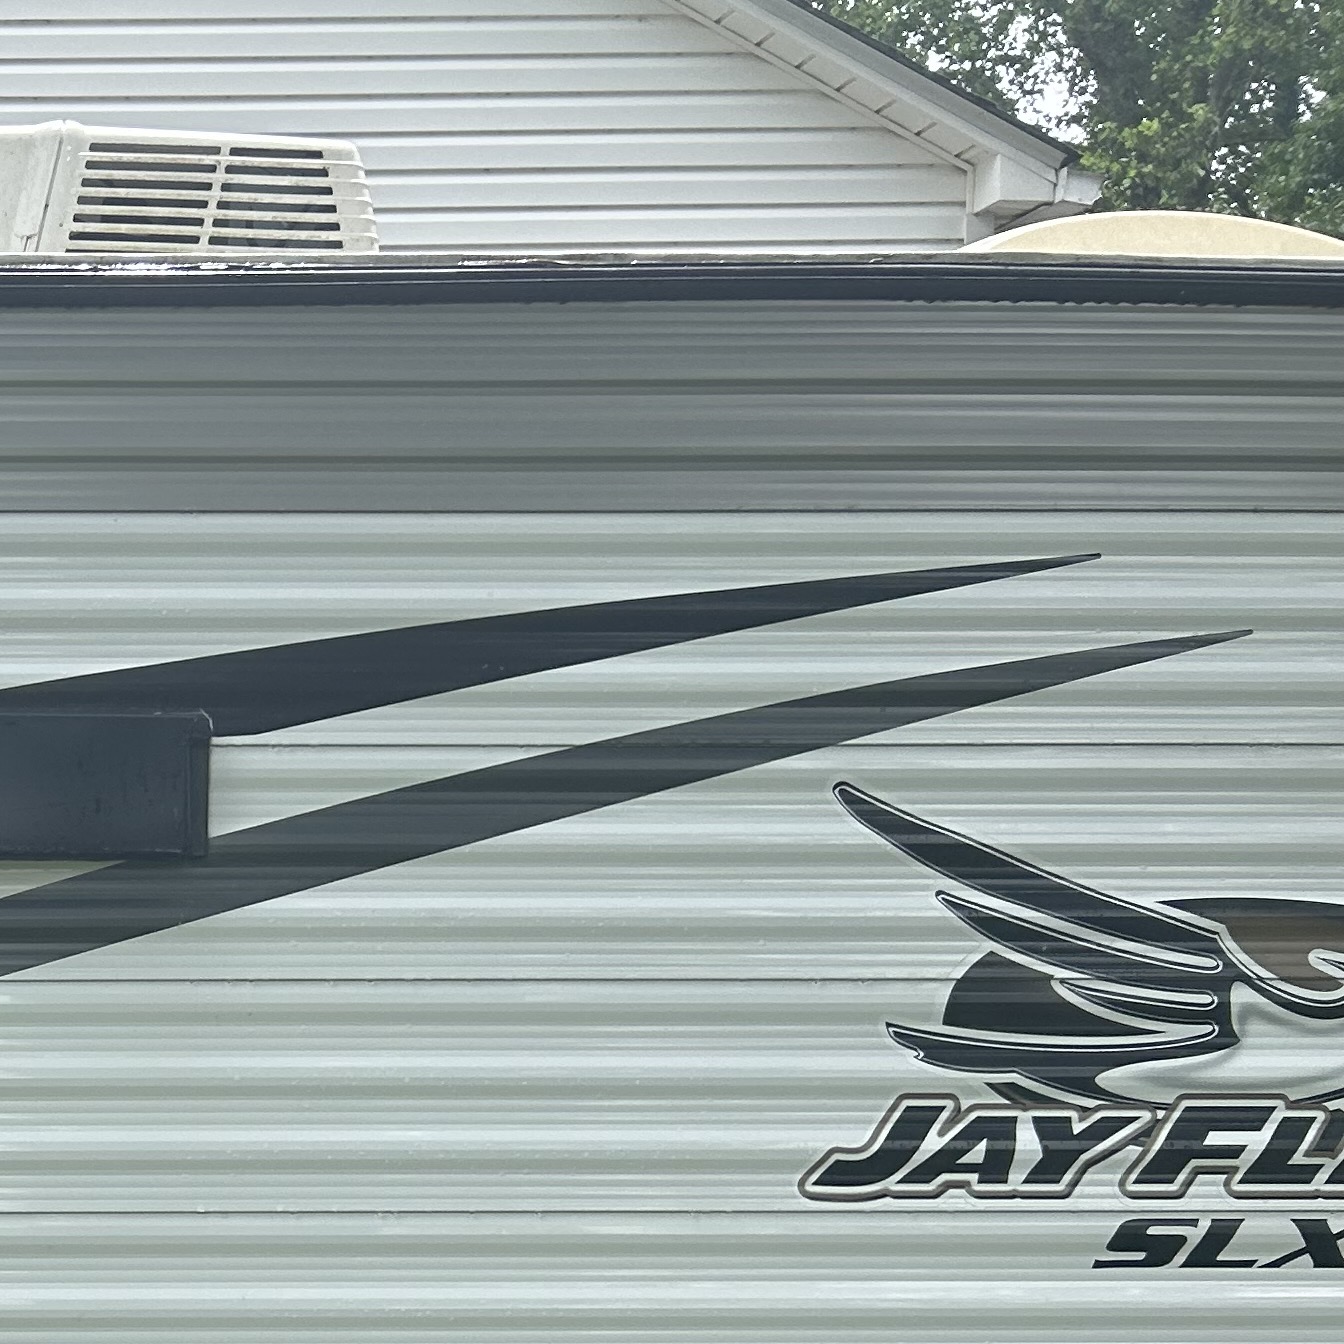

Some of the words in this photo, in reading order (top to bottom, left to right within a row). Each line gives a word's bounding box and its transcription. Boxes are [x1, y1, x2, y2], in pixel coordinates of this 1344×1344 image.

[802, 1096, 1155, 1197] JAY
[1120, 1095, 1344, 1198] FL
[1091, 1217, 1344, 1269] SLX
